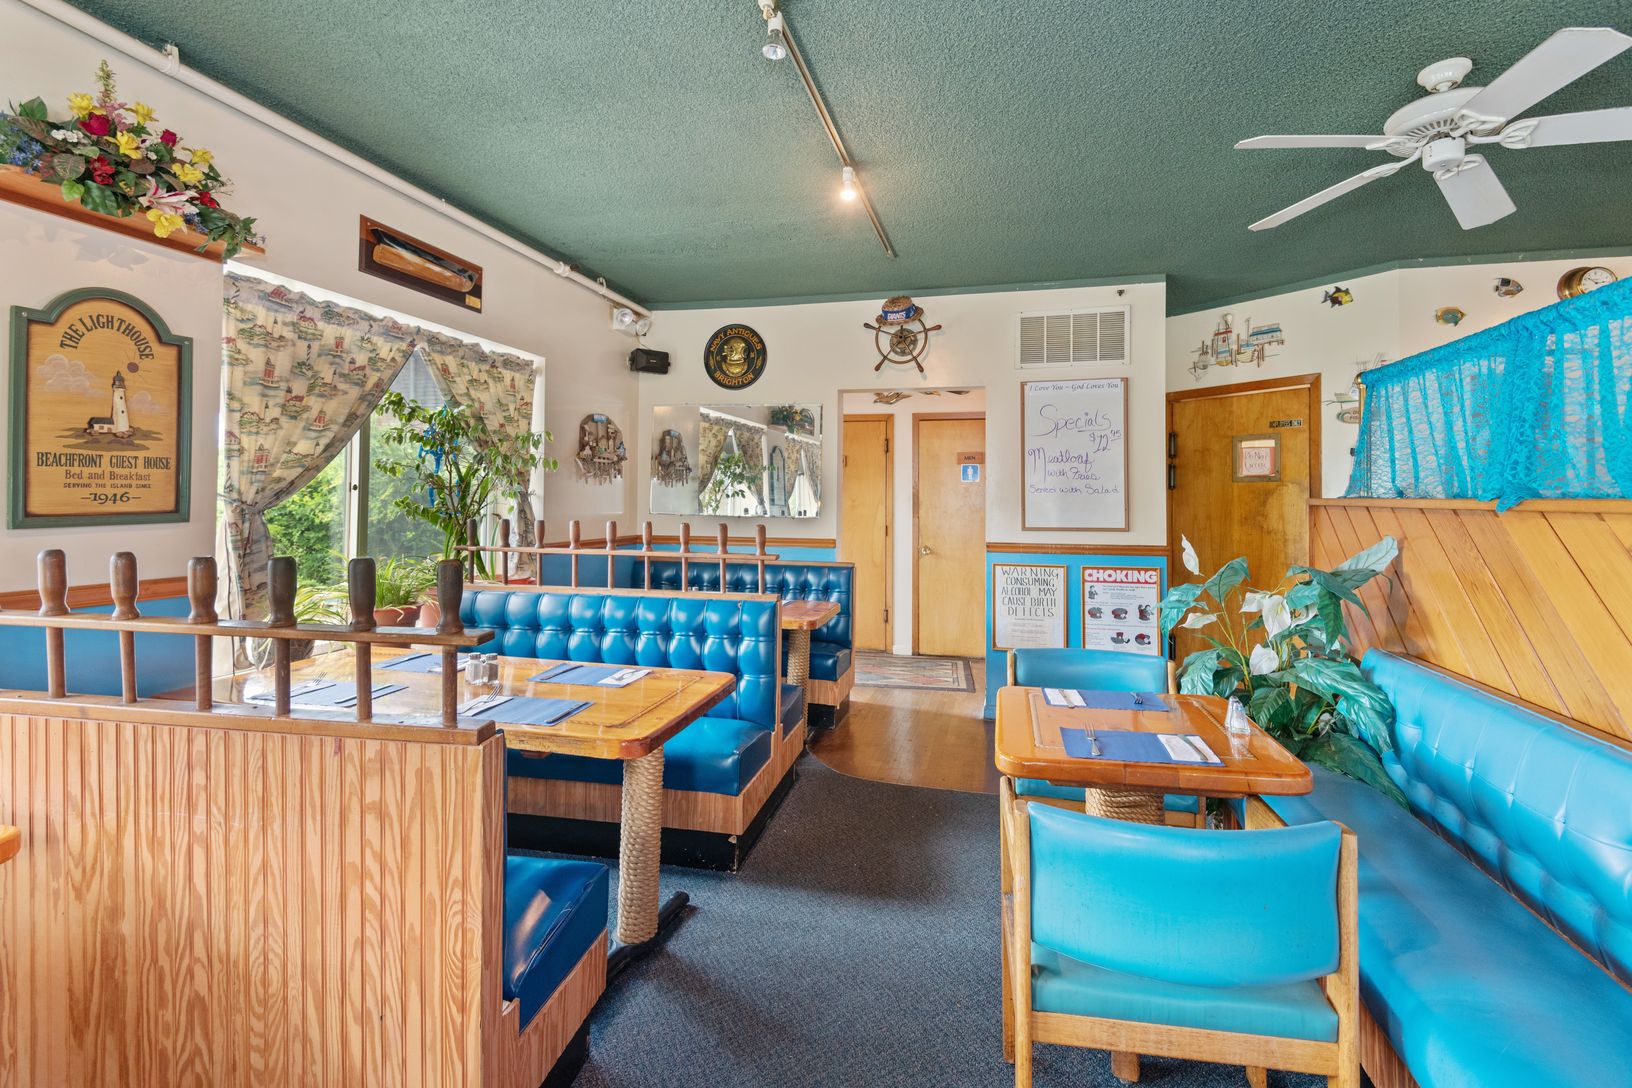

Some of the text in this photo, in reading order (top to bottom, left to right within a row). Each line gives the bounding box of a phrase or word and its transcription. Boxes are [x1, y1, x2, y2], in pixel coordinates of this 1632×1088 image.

[887, 311, 906, 321] GIANTS
[60, 313, 155, 360] THE LIGHTHOUSE
[709, 328, 763, 352] NAVY ANTIQUES
[714, 370, 754, 386] BRIGHTON
[1071, 383, 1085, 392] God
[1086, 382, 1105, 390] Loves
[1032, 404, 1112, 438] Specials
[36, 452, 172, 471] BEACHFRONT GUEST HOUSE
[1028, 447, 1095, 483] Meatloaf
[64, 469, 152, 481] Bed and Breakfast
[1047, 467, 1069, 479] with
[1084, 483, 1121, 495] Salad
[1005, 576, 1055, 587] CONSUMING
[1084, 569, 1158, 583] CHOKING
[1038, 588, 1058, 597] MAY
[1030, 598, 1057, 607] BIRTH
